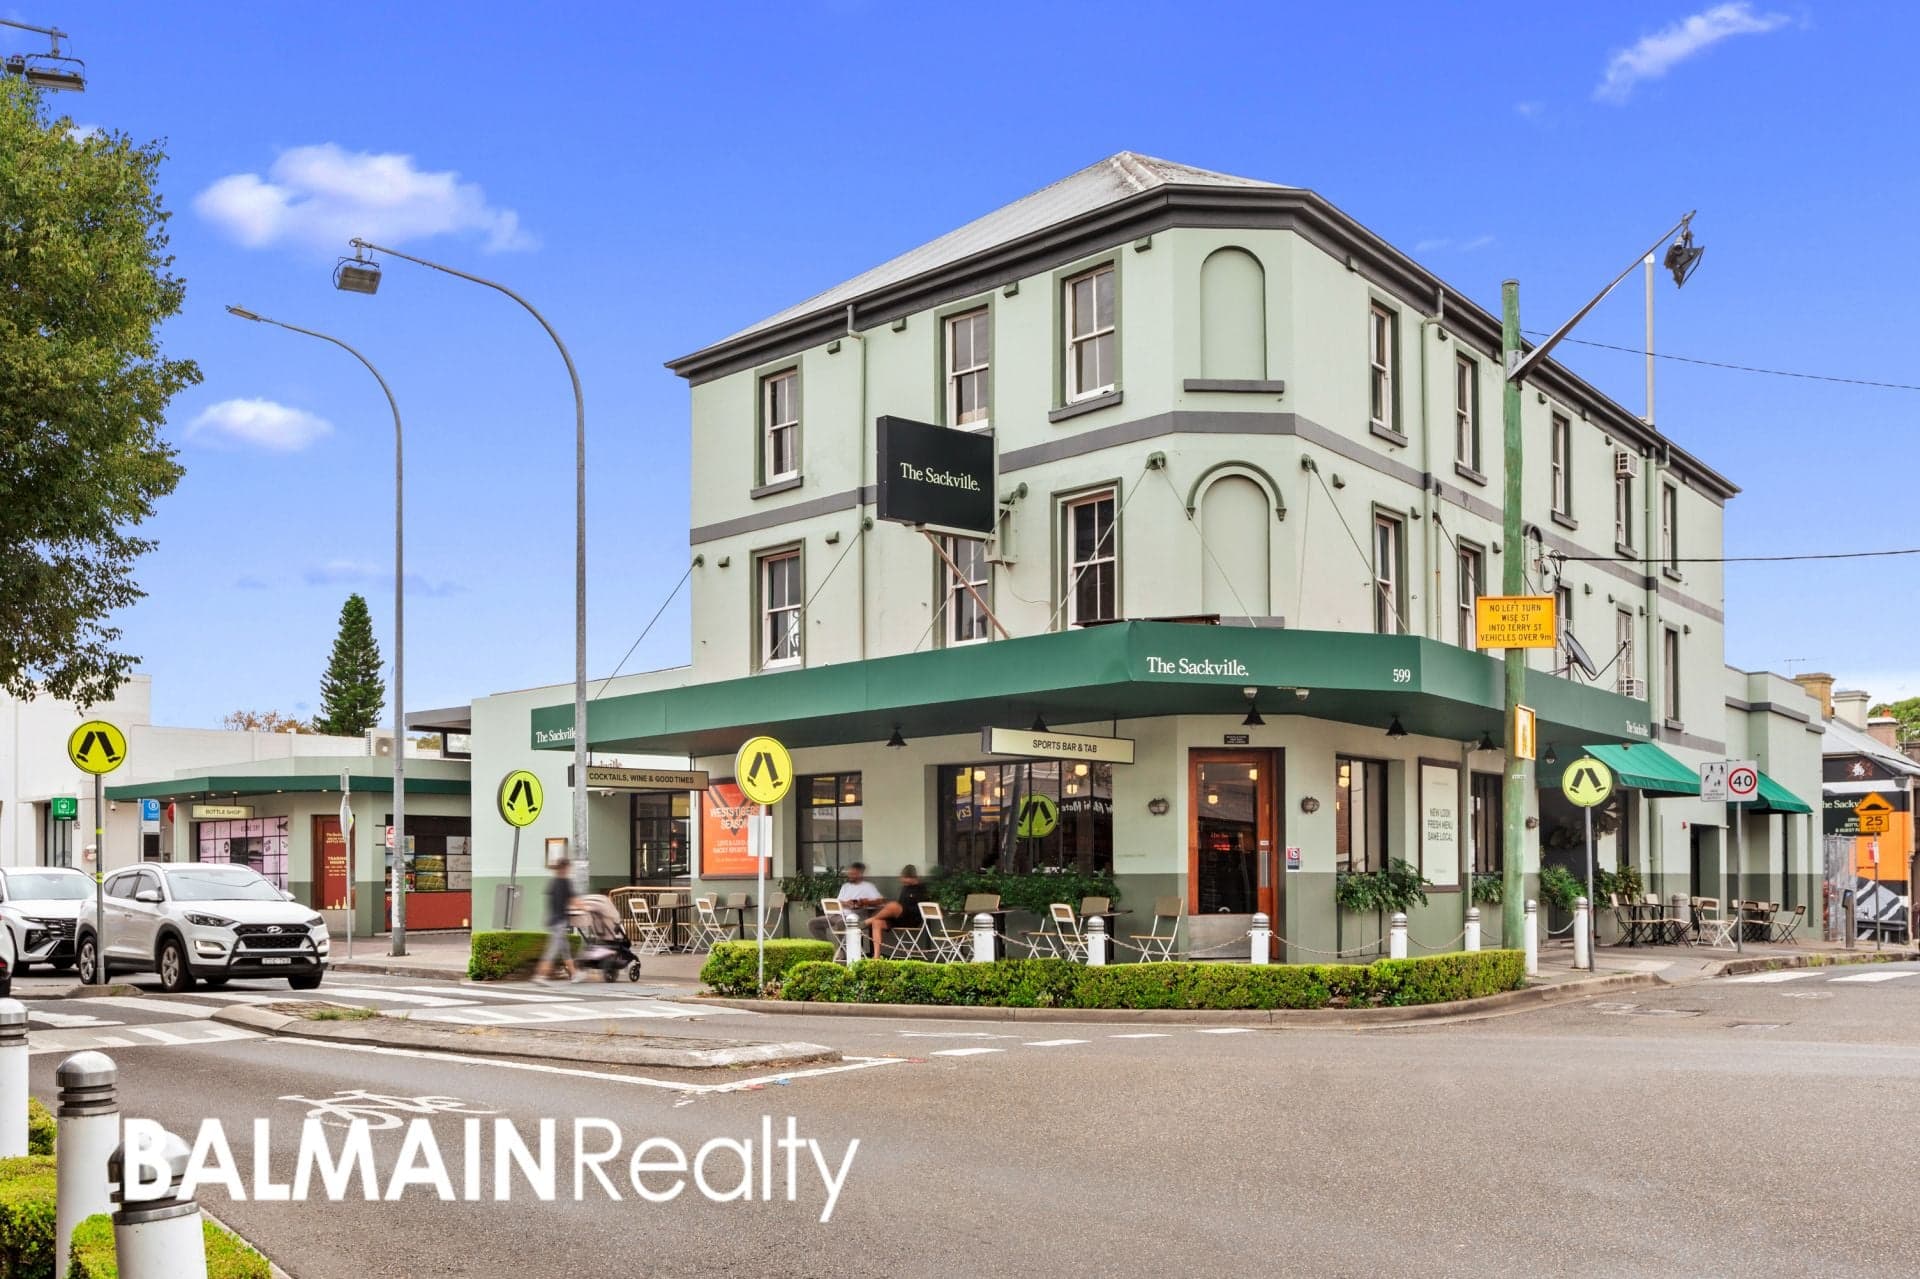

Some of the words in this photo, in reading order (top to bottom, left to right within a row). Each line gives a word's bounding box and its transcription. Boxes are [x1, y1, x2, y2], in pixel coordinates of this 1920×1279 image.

[900, 462, 923, 481] The
[925, 467, 981, 492] Sackville.
[1489, 604, 1500, 612] NO
[1502, 604, 1519, 612] LEFT
[1522, 604, 1541, 612] TURN
[1501, 614, 1518, 622] WISE
[1520, 614, 1529, 622] ST
[1488, 623, 1506, 632] INTO
[1508, 623, 1531, 632] TERRY
[1533, 623, 1542, 632] ST
[1480, 633, 1516, 641] VEHICLES
[1518, 633, 1537, 641] OVER
[1146, 656, 1176, 674] The
[1178, 658, 1249, 677] Sackville.
[1393, 669, 1411, 683] 599
[535, 731, 548, 744] The
[1032, 739, 1061, 751] SPORTS
[1062, 742, 1077, 752] BAR
[1078, 743, 1083, 752] &
[1084, 744, 1098, 753] TAB
[630, 774, 648, 783] WINE
[655, 775, 674, 784] GOOD
[675, 776, 694, 785] TIMES
[1733, 775, 1753, 787] 40
[1866, 815, 1884, 827] 25
